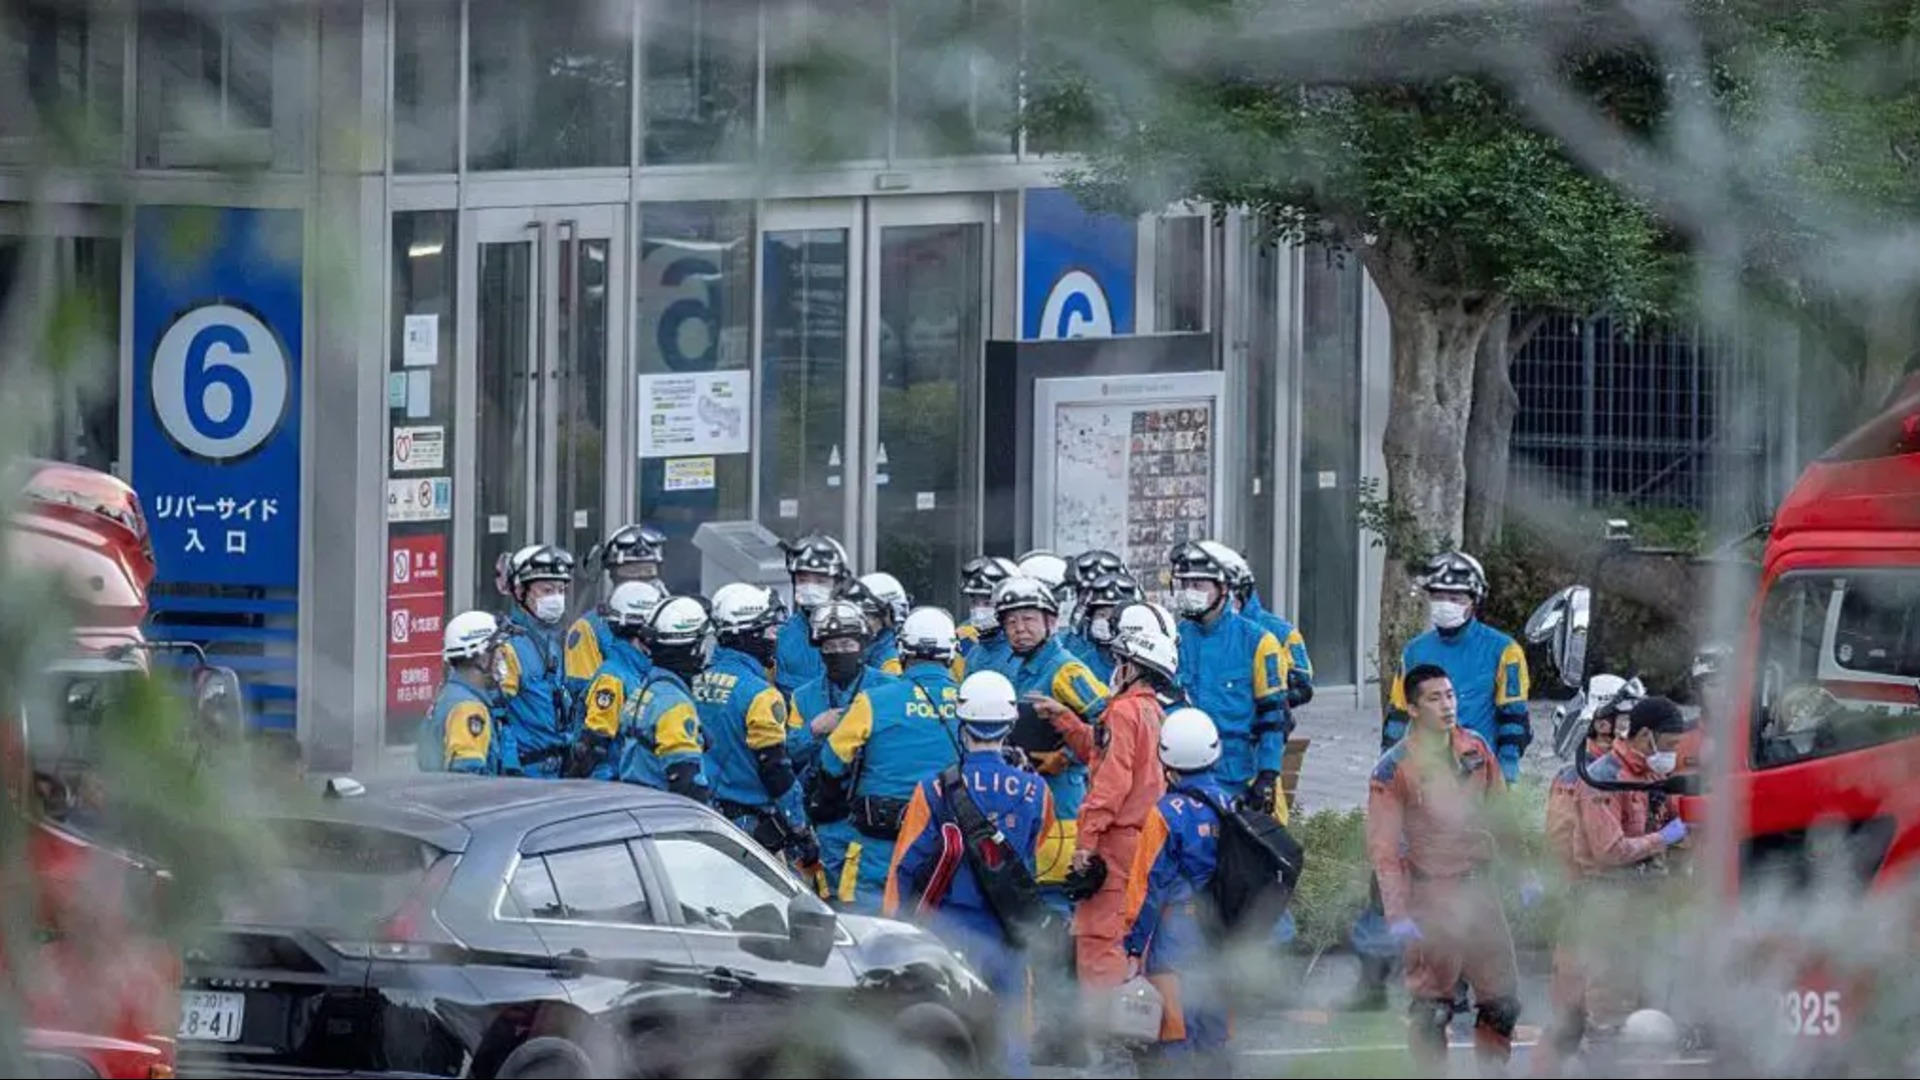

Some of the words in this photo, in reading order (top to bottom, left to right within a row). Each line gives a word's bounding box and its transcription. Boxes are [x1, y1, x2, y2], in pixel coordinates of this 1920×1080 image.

[184, 324, 252, 440] 6
[156, 496, 278, 521] リバーサイド
[185, 528, 247, 553] 入口
[906, 702, 955, 718] POLIC
[933, 771, 1037, 802] LICE
[180, 1011, 233, 1037] 8-41
[1778, 990, 1841, 1035] 325
